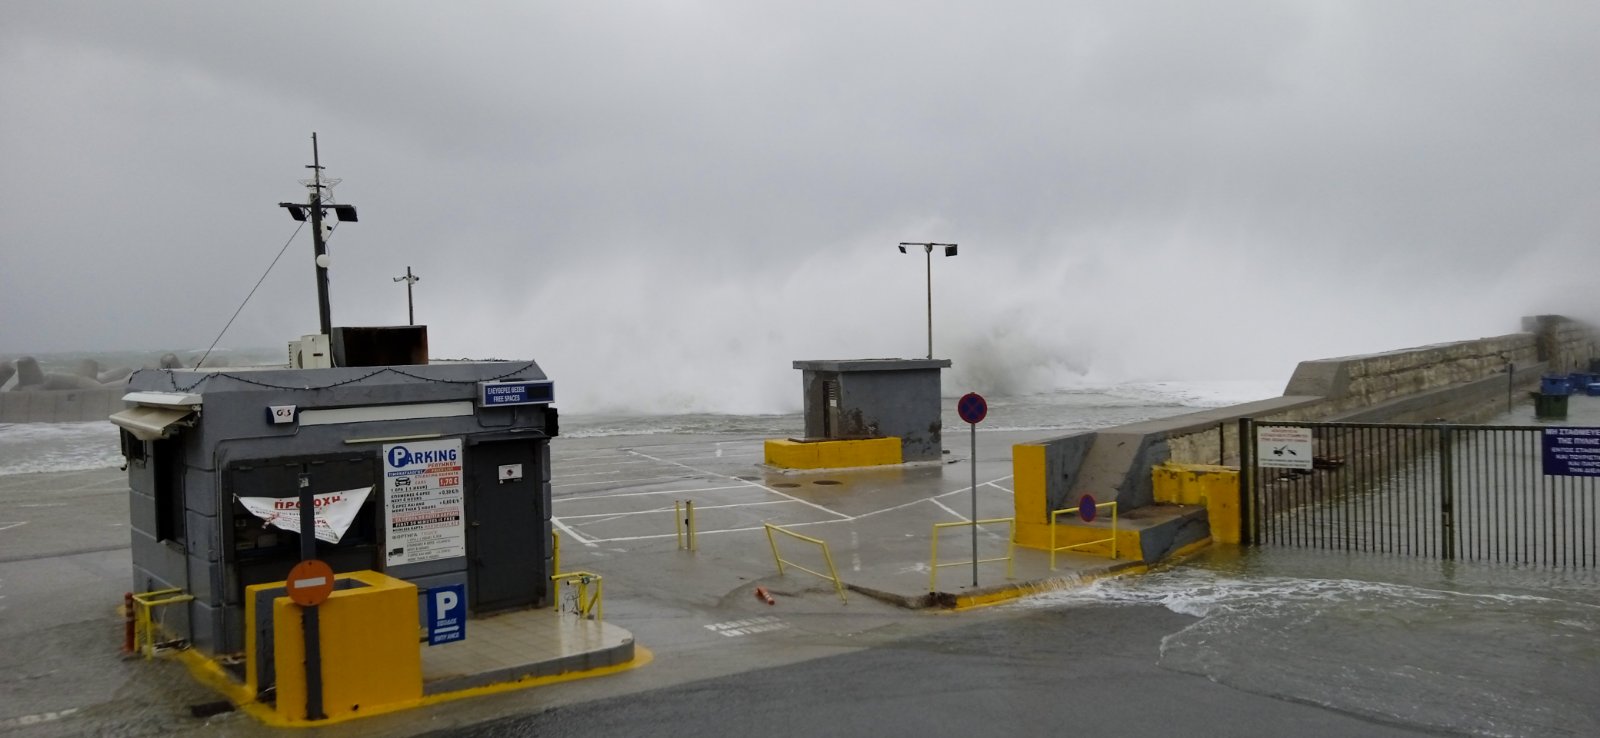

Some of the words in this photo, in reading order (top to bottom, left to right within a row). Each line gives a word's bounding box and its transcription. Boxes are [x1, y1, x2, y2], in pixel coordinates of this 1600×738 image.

[393, 448, 456, 466] PARKING
[274, 496, 340, 509] ΠΡΟΟΧΗ
[436, 591, 458, 620] P
